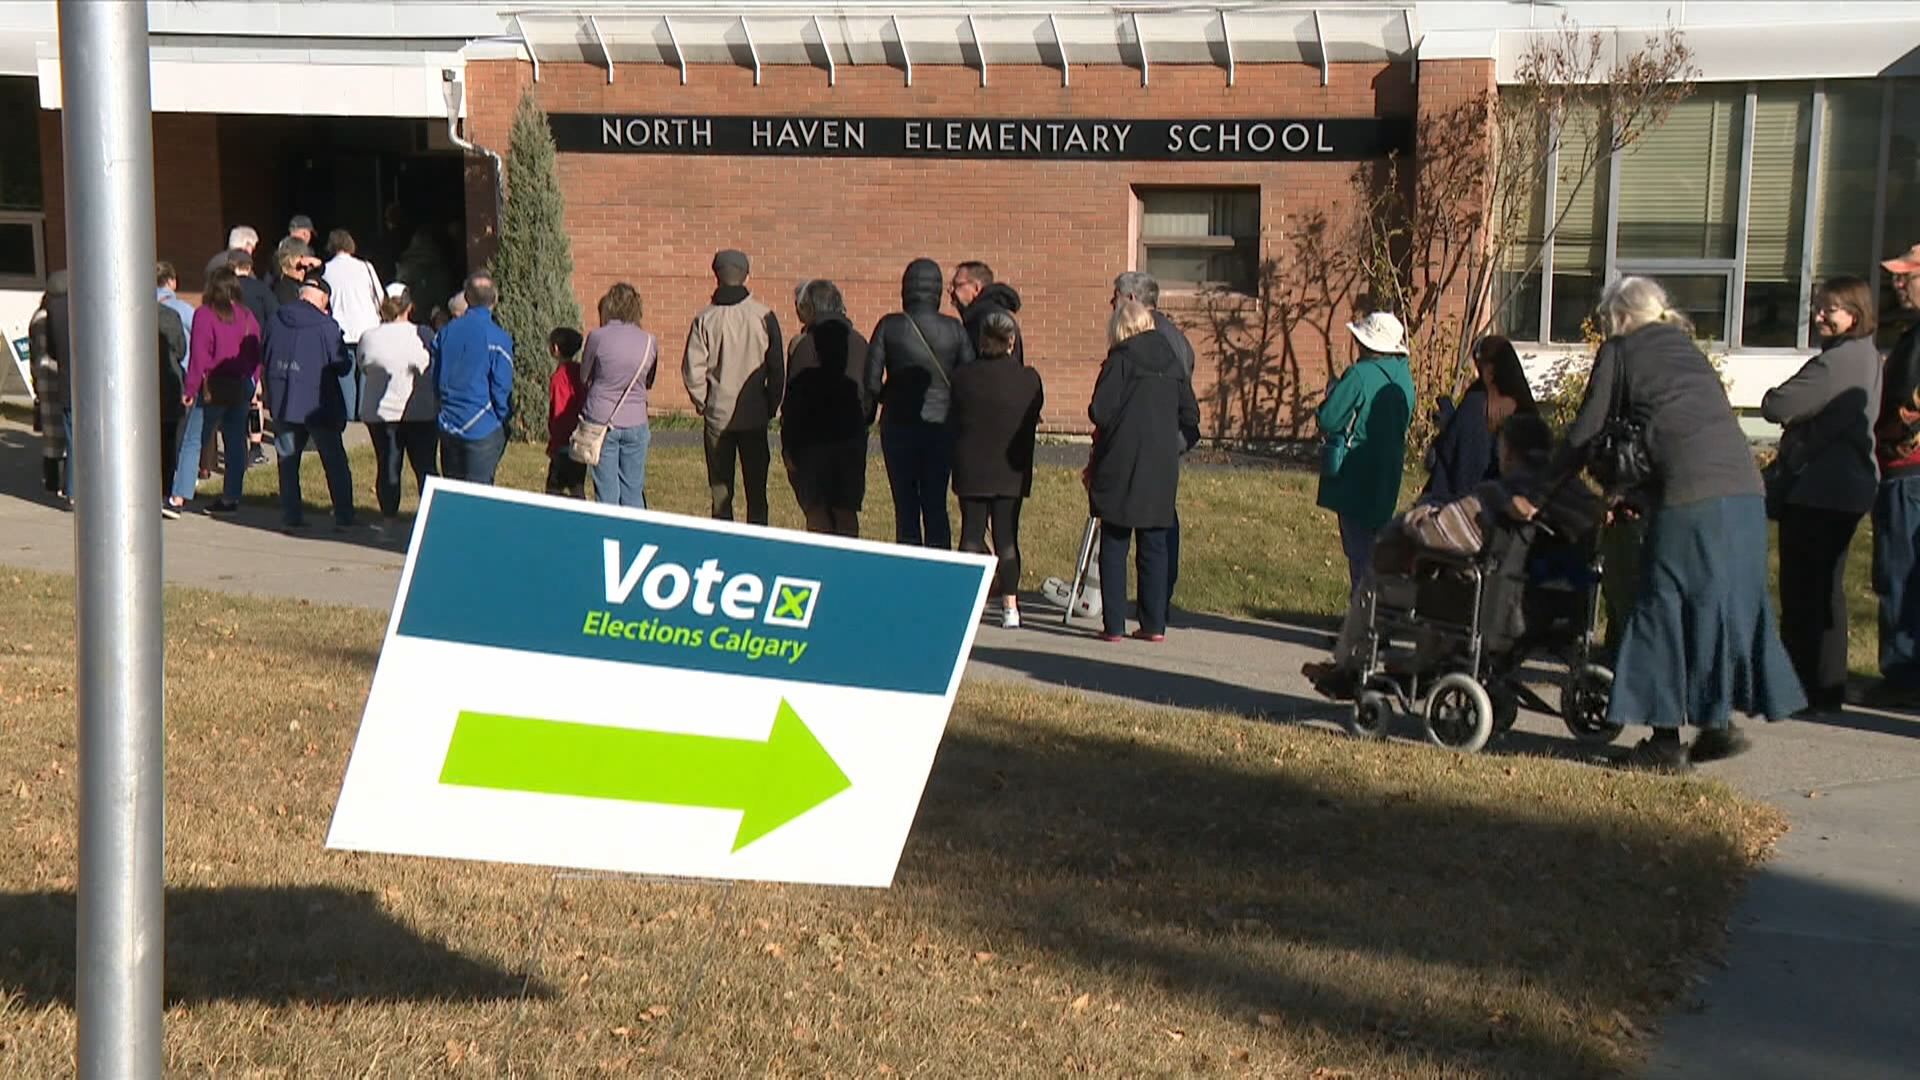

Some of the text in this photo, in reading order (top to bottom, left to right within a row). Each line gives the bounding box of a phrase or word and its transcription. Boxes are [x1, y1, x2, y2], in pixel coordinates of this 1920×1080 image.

[601, 117, 1335, 152] NORTH HAVEN ELEMENTARY SCHOOL
[603, 538, 764, 620] Vote
[582, 610, 808, 664] Elections Calgary
